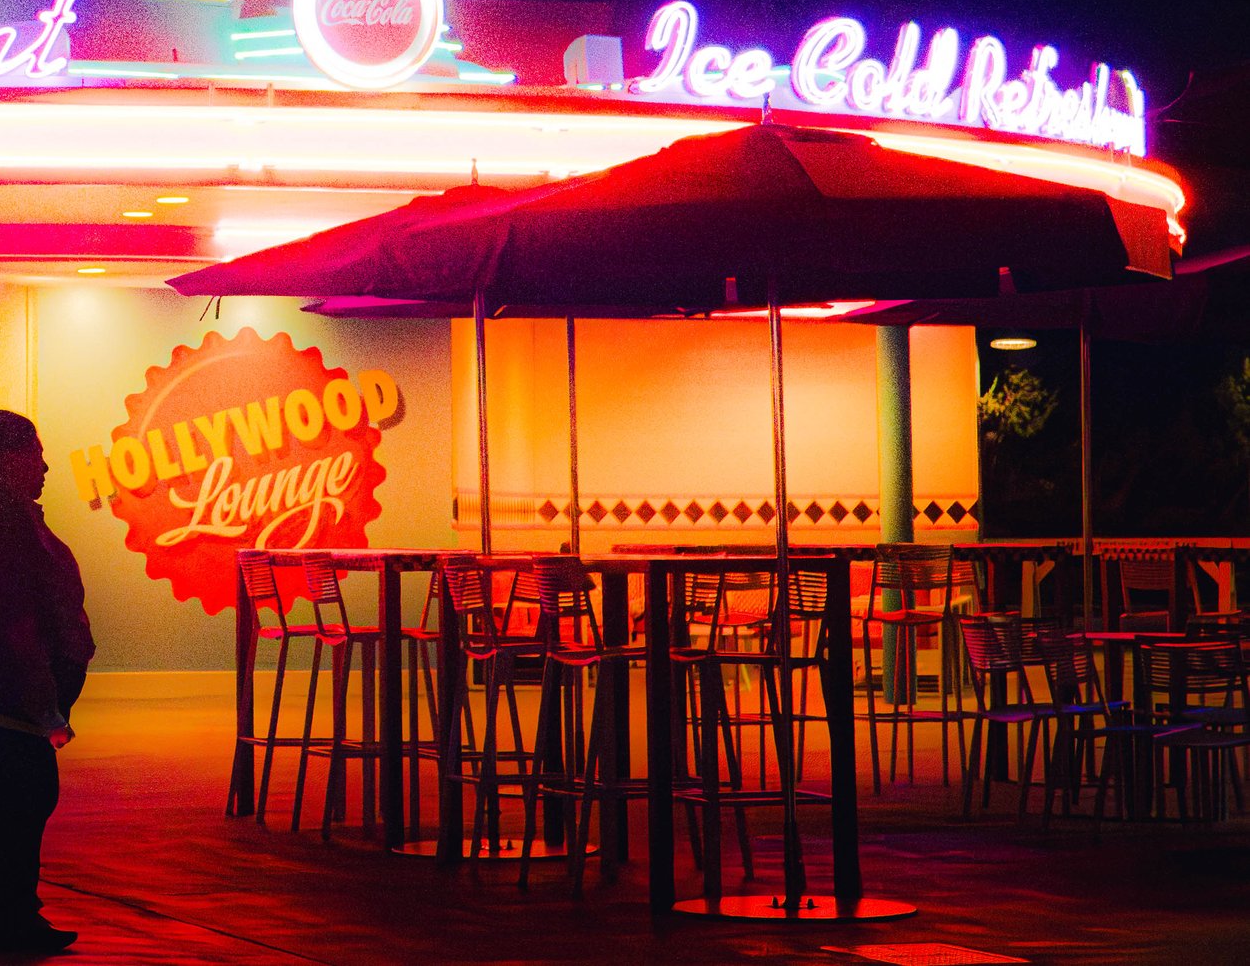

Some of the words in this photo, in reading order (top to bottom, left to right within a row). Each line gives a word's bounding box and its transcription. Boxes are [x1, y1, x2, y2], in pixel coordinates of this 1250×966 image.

[635, 0, 777, 97] Ice
[790, 15, 960, 119] Cold
[70, 369, 401, 506] HOLLYWOOD
[156, 450, 356, 549] Lounge
